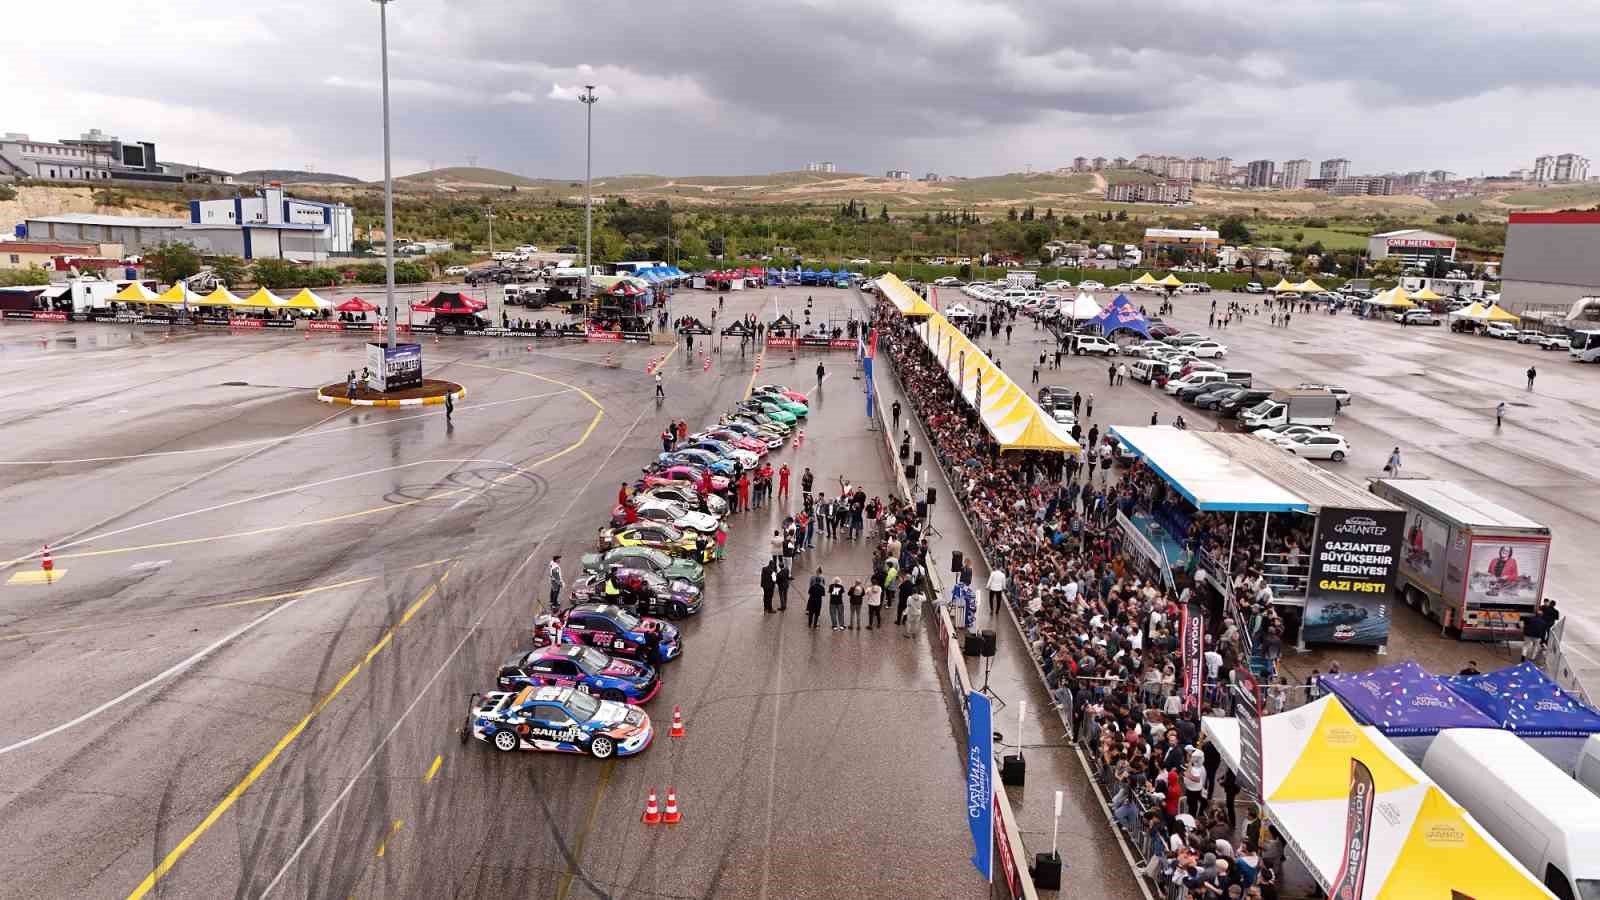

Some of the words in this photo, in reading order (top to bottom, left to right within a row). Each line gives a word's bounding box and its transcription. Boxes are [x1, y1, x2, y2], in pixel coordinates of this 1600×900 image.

[1325, 541, 1391, 553] GAZİANTEP
[1320, 551, 1393, 565] BÜYÜKŞEHİR
[1322, 563, 1387, 576] BELEDİYESİ
